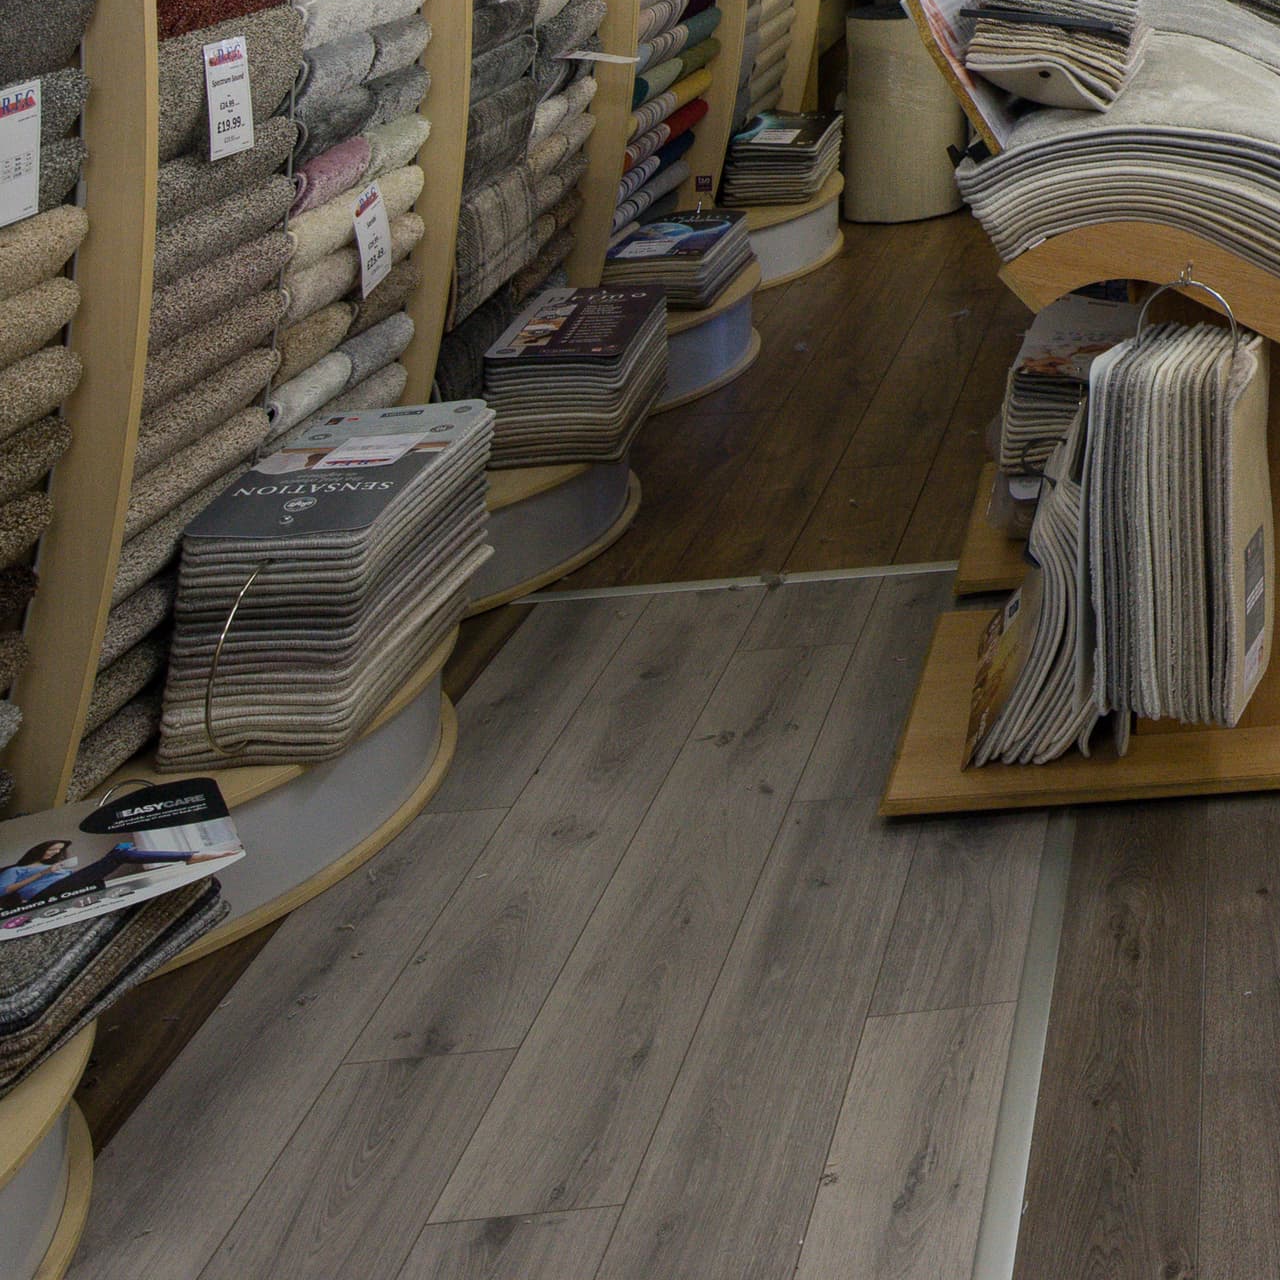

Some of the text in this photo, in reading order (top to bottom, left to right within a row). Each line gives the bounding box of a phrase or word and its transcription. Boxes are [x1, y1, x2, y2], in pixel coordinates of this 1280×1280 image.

[217, 116, 241, 134] £19.99
[233, 480, 395, 497] SENSATION
[121, 793, 207, 818] EASYCARE
[0, 899, 46, 918] Sahara
[47, 895, 58, 904] &
[60, 884, 97, 900] Oasis
